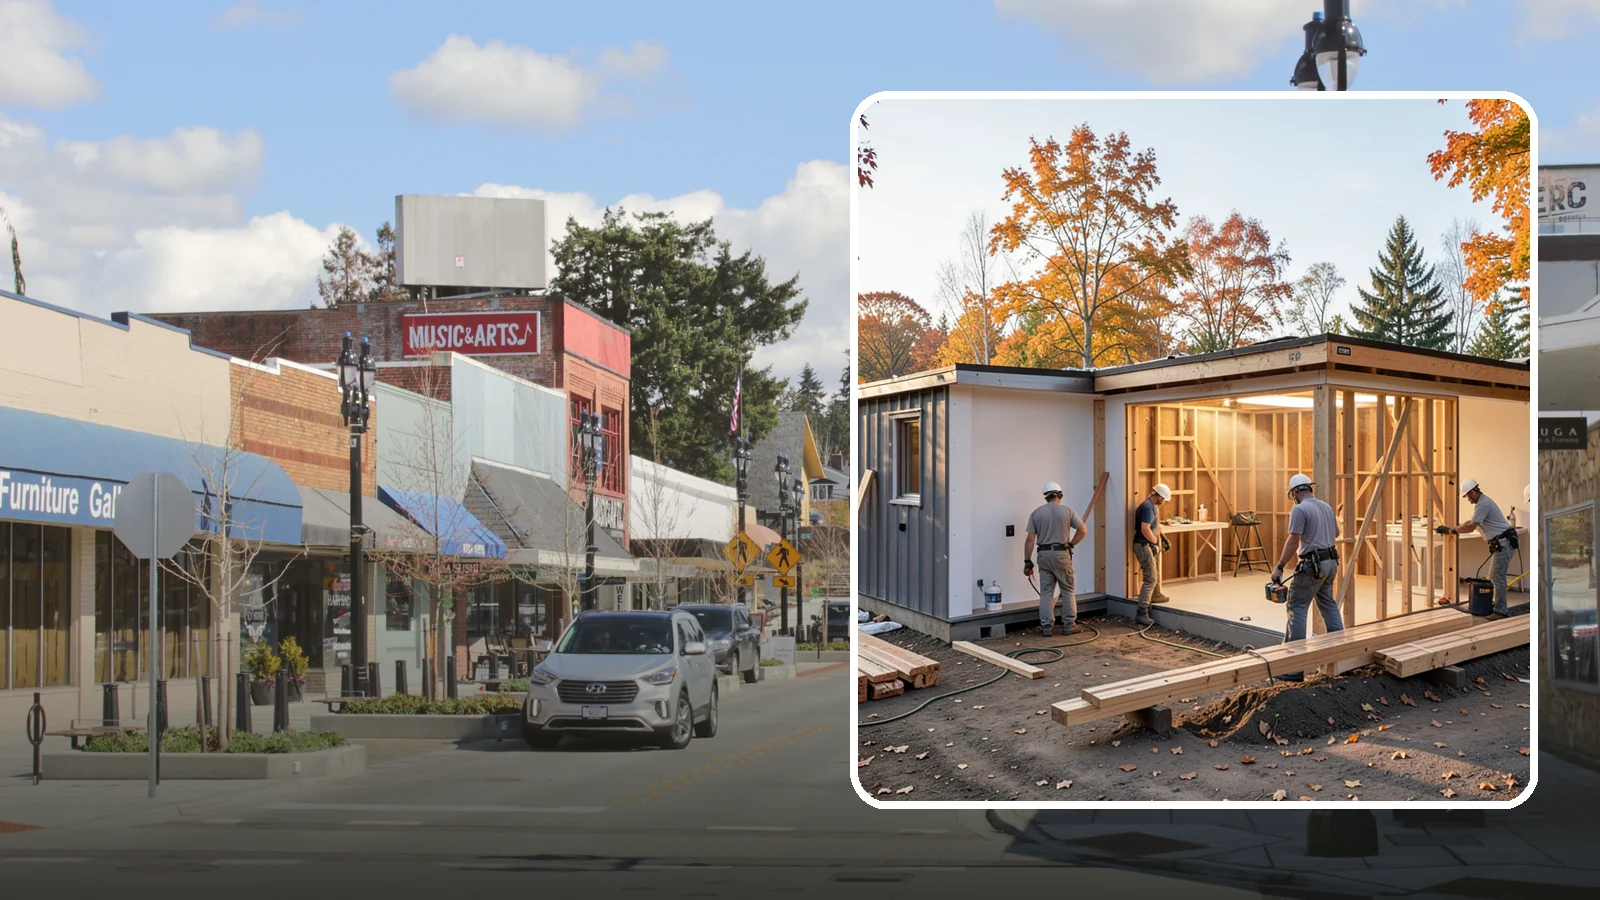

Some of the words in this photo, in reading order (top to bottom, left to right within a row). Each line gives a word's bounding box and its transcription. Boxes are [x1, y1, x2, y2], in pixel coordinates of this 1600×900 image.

[0, 471, 79, 515] Furniture
[89, 482, 122, 519] Gal
[453, 562, 479, 575] SUSHI
